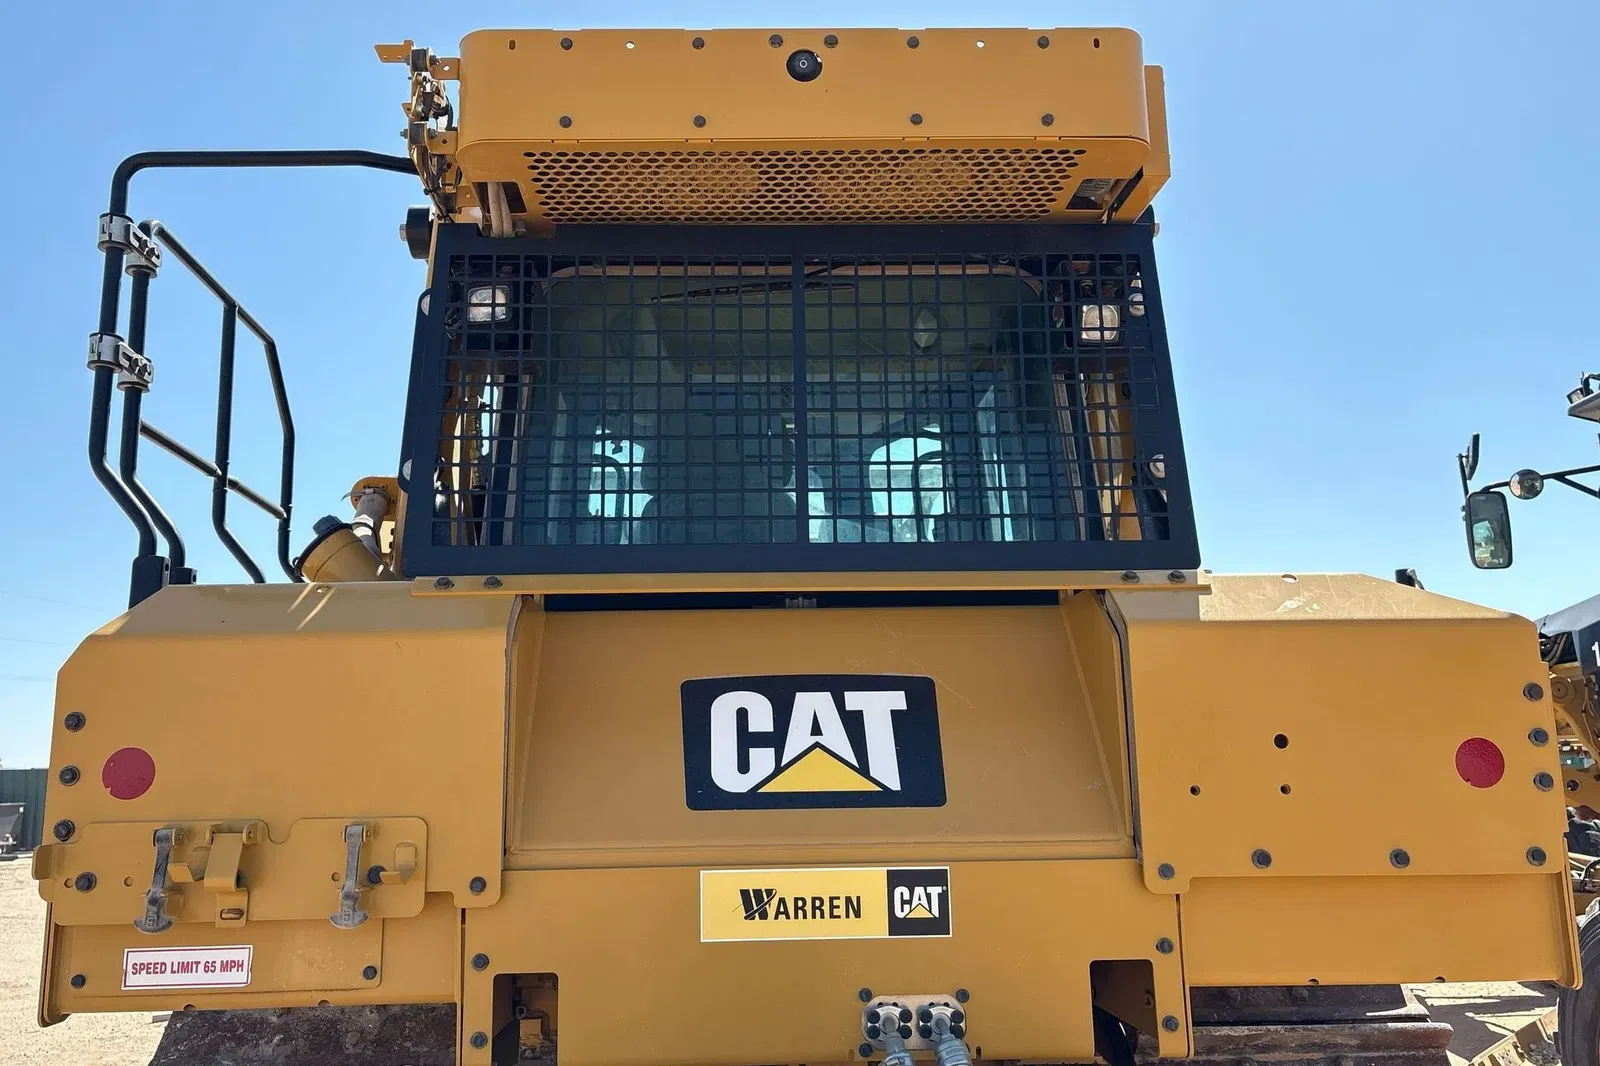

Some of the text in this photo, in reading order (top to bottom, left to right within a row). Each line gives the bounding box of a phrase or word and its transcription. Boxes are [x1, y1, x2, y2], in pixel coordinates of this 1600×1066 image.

[710, 690, 908, 793] CAT
[739, 888, 862, 920] WARREN
[131, 959, 245, 976] SPEED LIMIT 65 MPH
